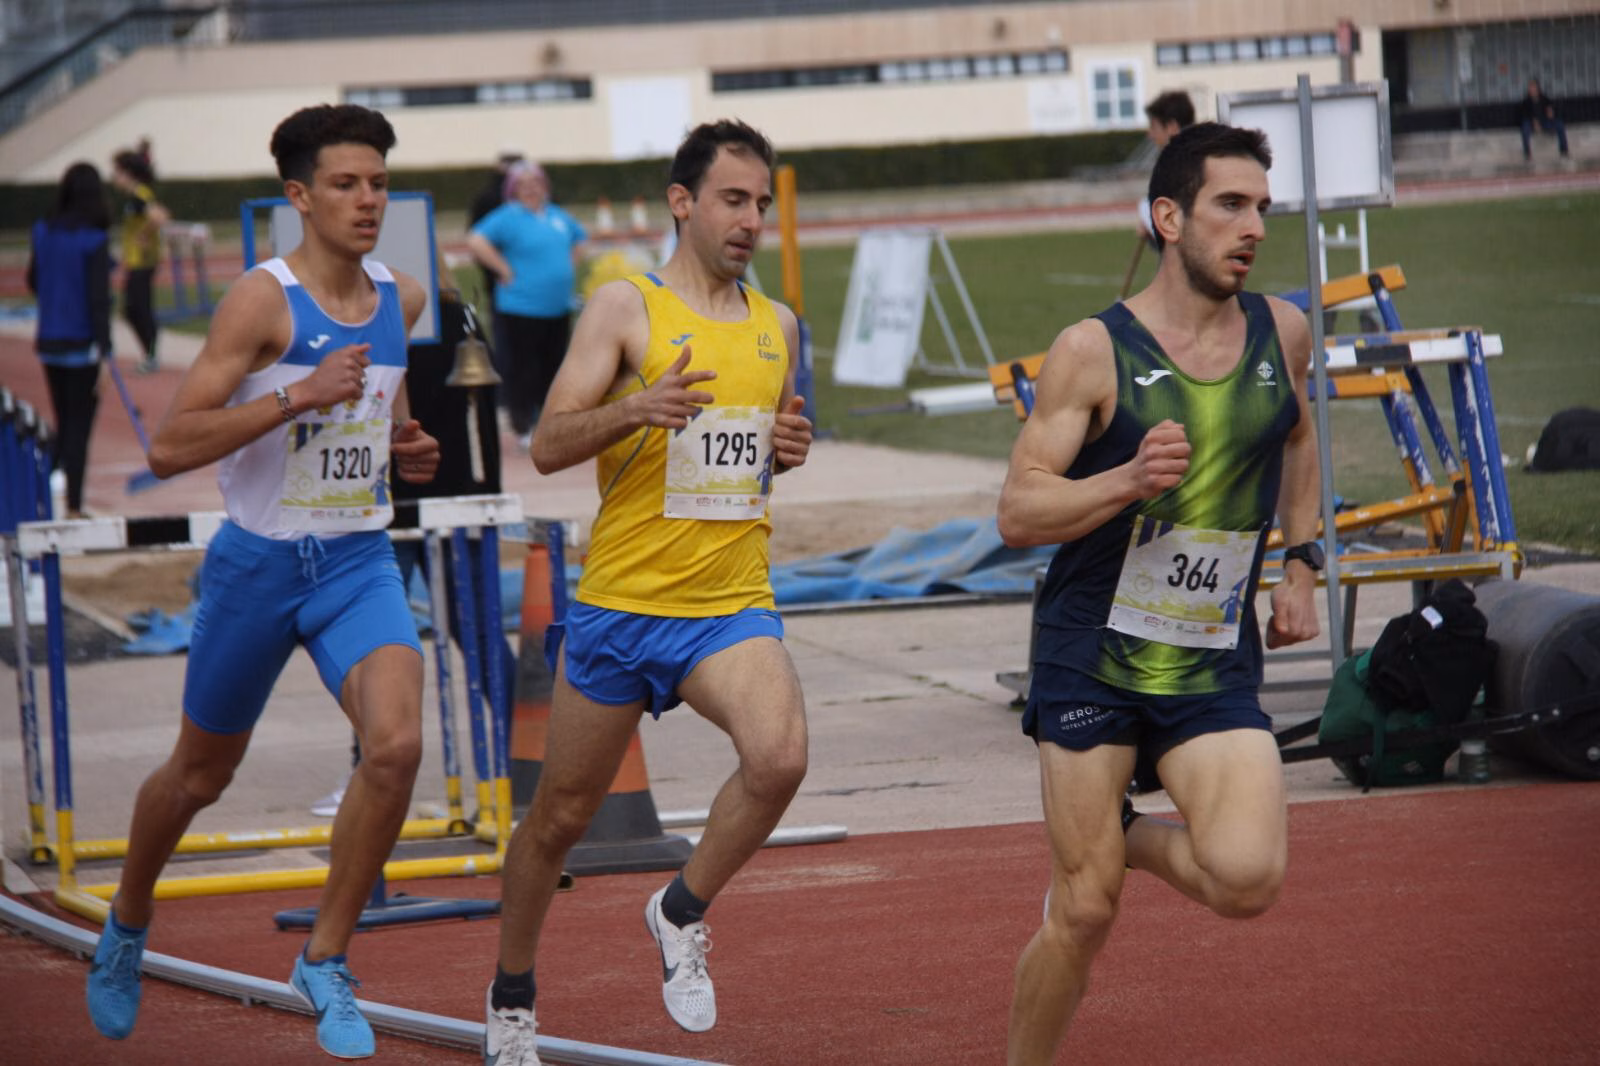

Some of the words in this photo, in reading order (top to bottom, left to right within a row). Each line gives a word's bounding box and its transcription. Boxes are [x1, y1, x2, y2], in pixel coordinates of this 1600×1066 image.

[319, 446, 371, 480] 1320
[701, 432, 757, 466] 1295
[1167, 553, 1220, 593] 364
